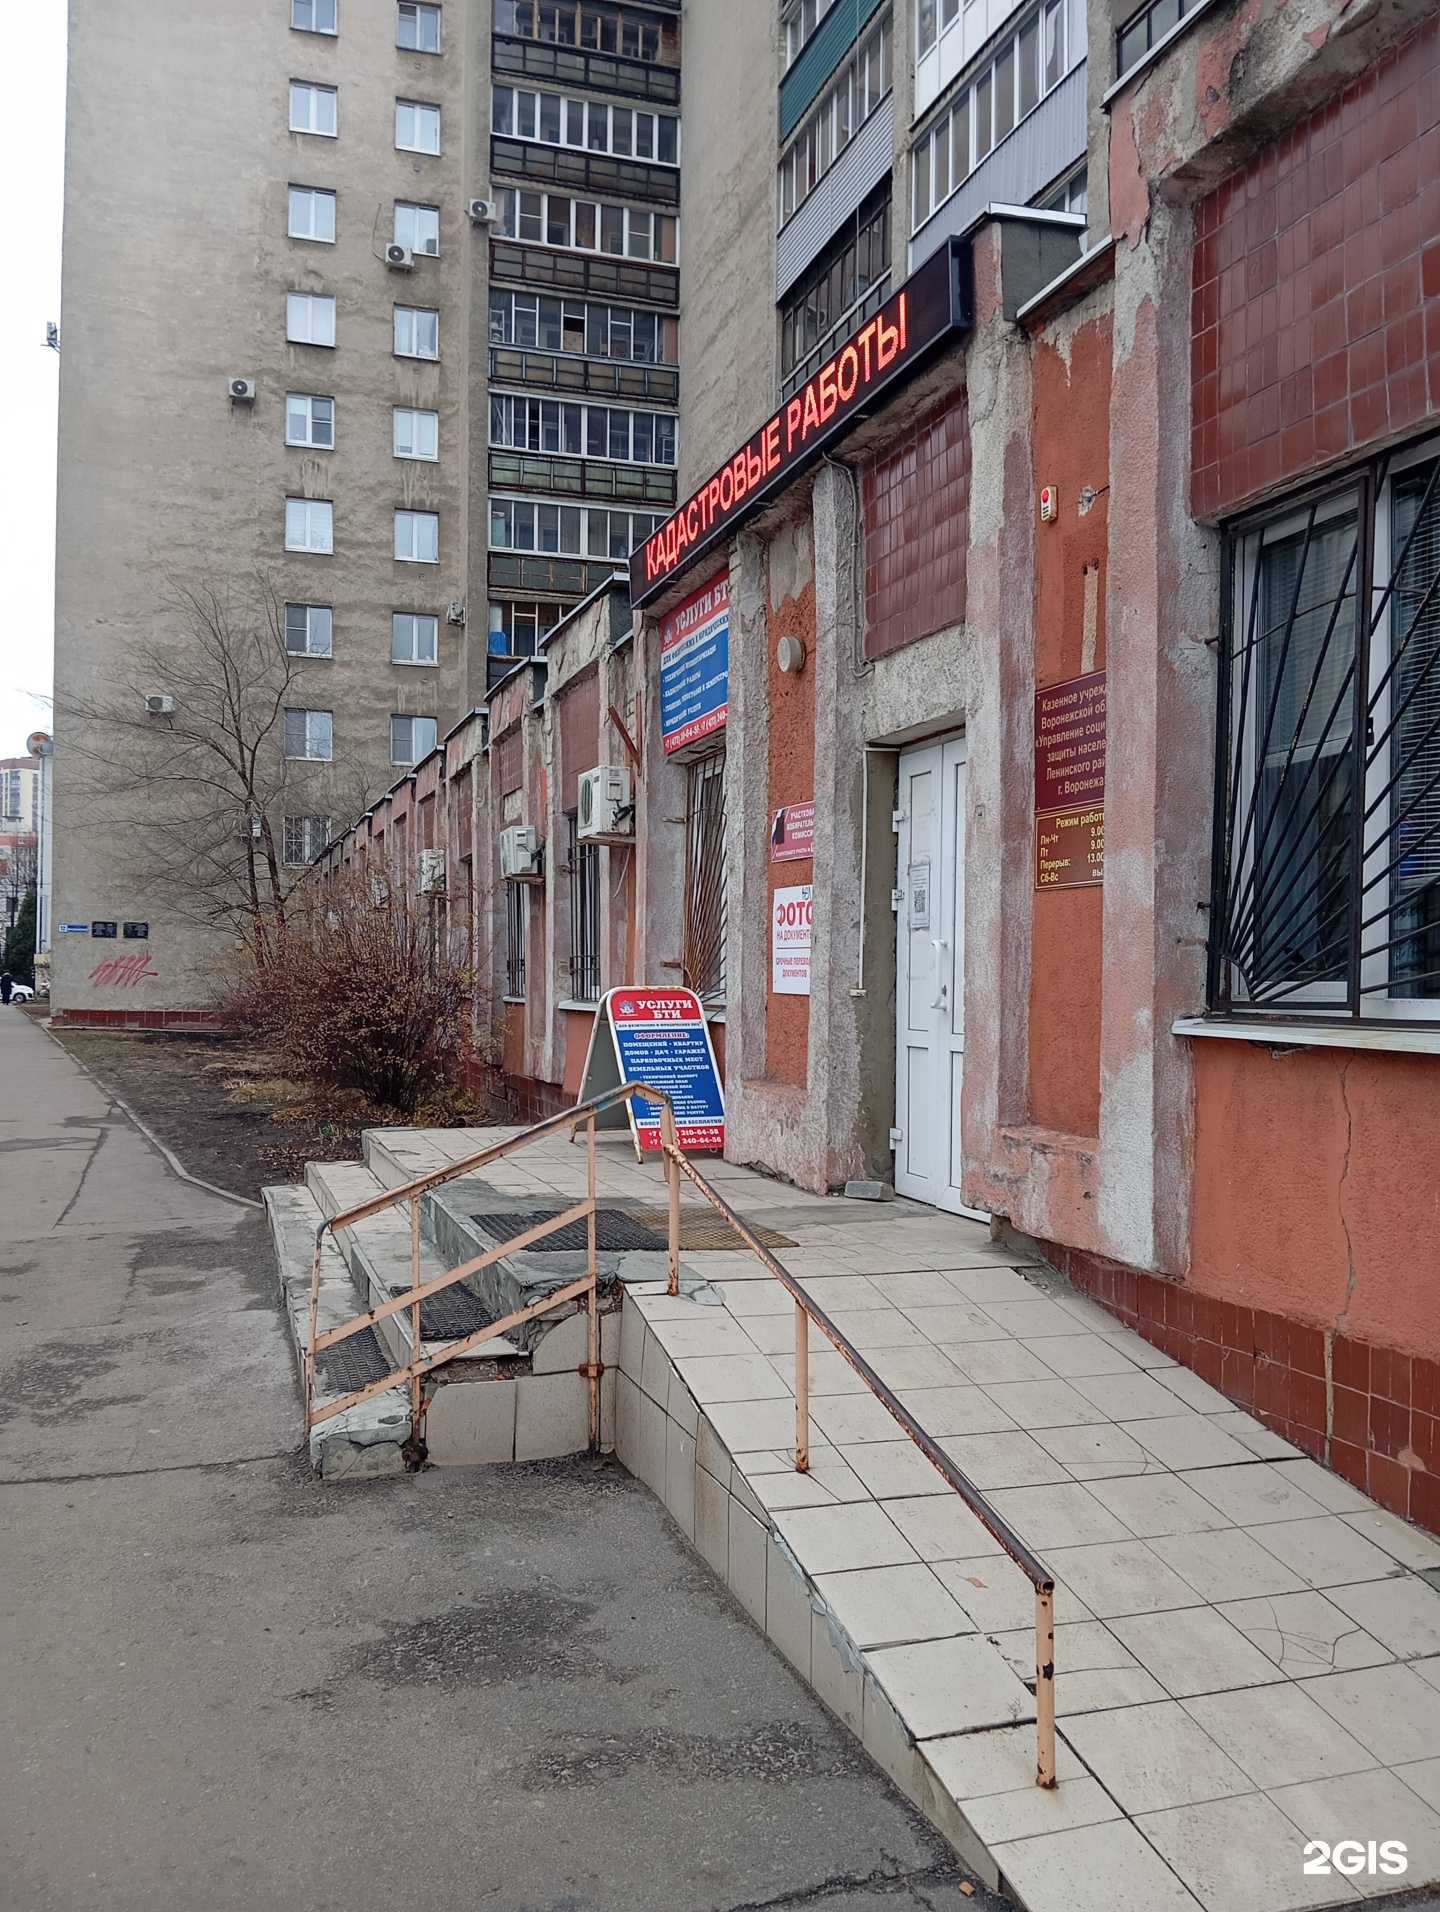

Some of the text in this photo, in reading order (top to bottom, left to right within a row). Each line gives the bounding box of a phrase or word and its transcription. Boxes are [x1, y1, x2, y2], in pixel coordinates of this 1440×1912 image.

[646, 292, 906, 581] КАДАСТРОВЫЕ РАБОТЫ
[675, 578, 730, 635] УСЛУГИ БТ
[1041, 683, 1106, 712] Казенное учреж
[1041, 703, 1093, 730] Воронежской
[1036, 727, 1084, 748] «Управление
[1047, 738, 1106, 763] защиты населе
[1046, 762, 1090, 781] Ленинского
[1058, 776, 1104, 796] г. Воронежа
[1056, 816, 1079, 829] Режим
[1040, 833, 1059, 845] Пн-Чт
[1040, 847, 1049, 857] Пт
[1040, 858, 1071, 870] Перерыв:
[1040, 871, 1059, 883] Сб-Вс
[776, 900, 814, 926] ФОТО
[636, 1000, 693, 1009] УСЛУГИ
[653, 1009, 681, 1019] БТИ
